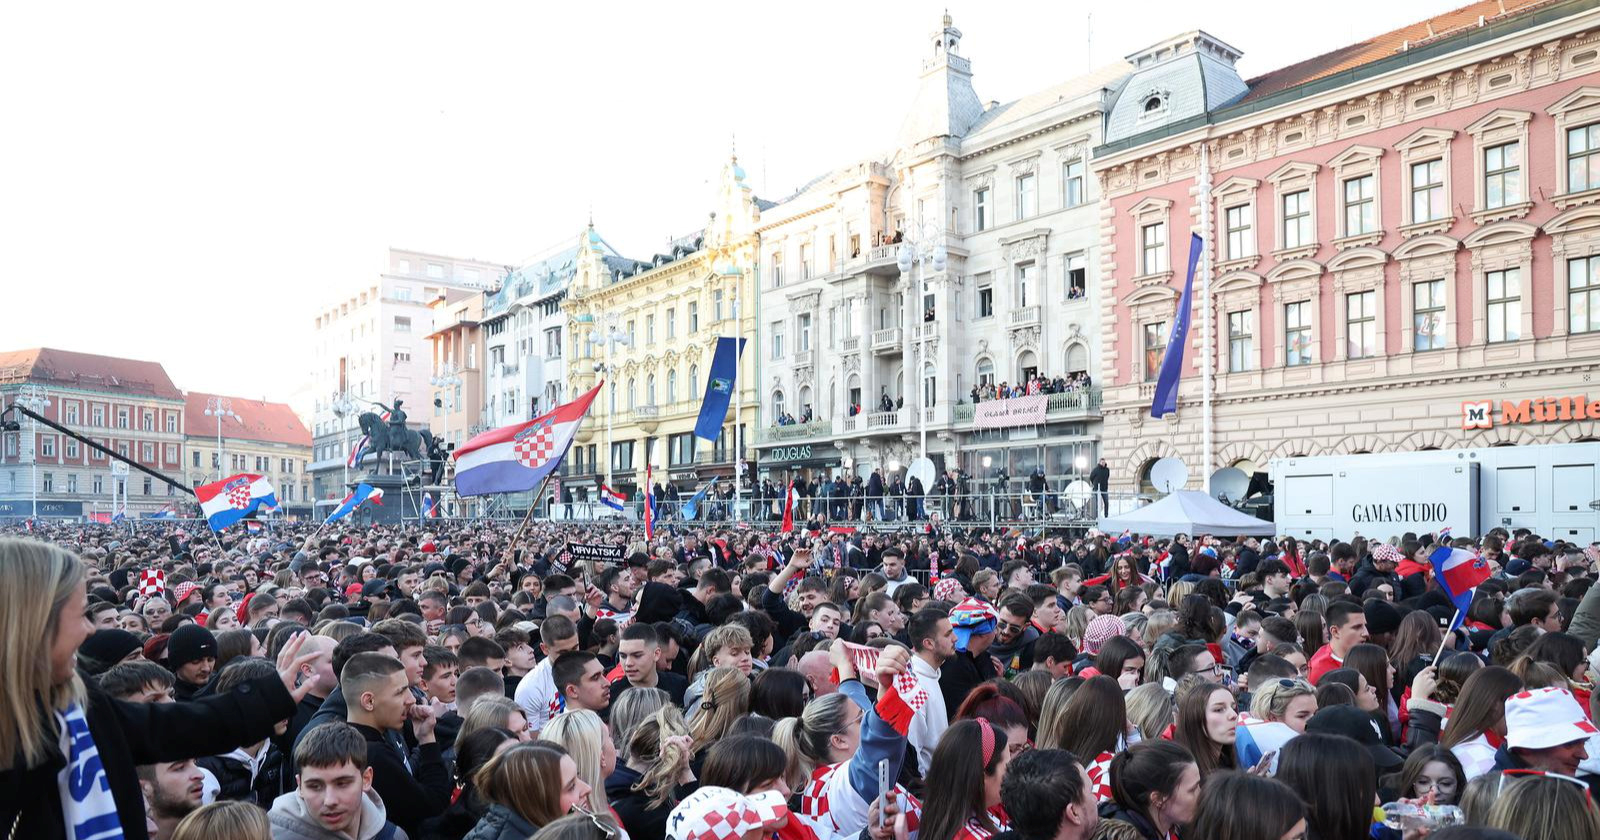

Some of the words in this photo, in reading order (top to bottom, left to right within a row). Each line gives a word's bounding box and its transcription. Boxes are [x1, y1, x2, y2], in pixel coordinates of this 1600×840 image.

[772, 445, 811, 461] DOUGLAS
[1352, 504, 1392, 523] GAMA
[1395, 502, 1447, 523] STUDIO
[572, 545, 622, 557] HRVATSKA
